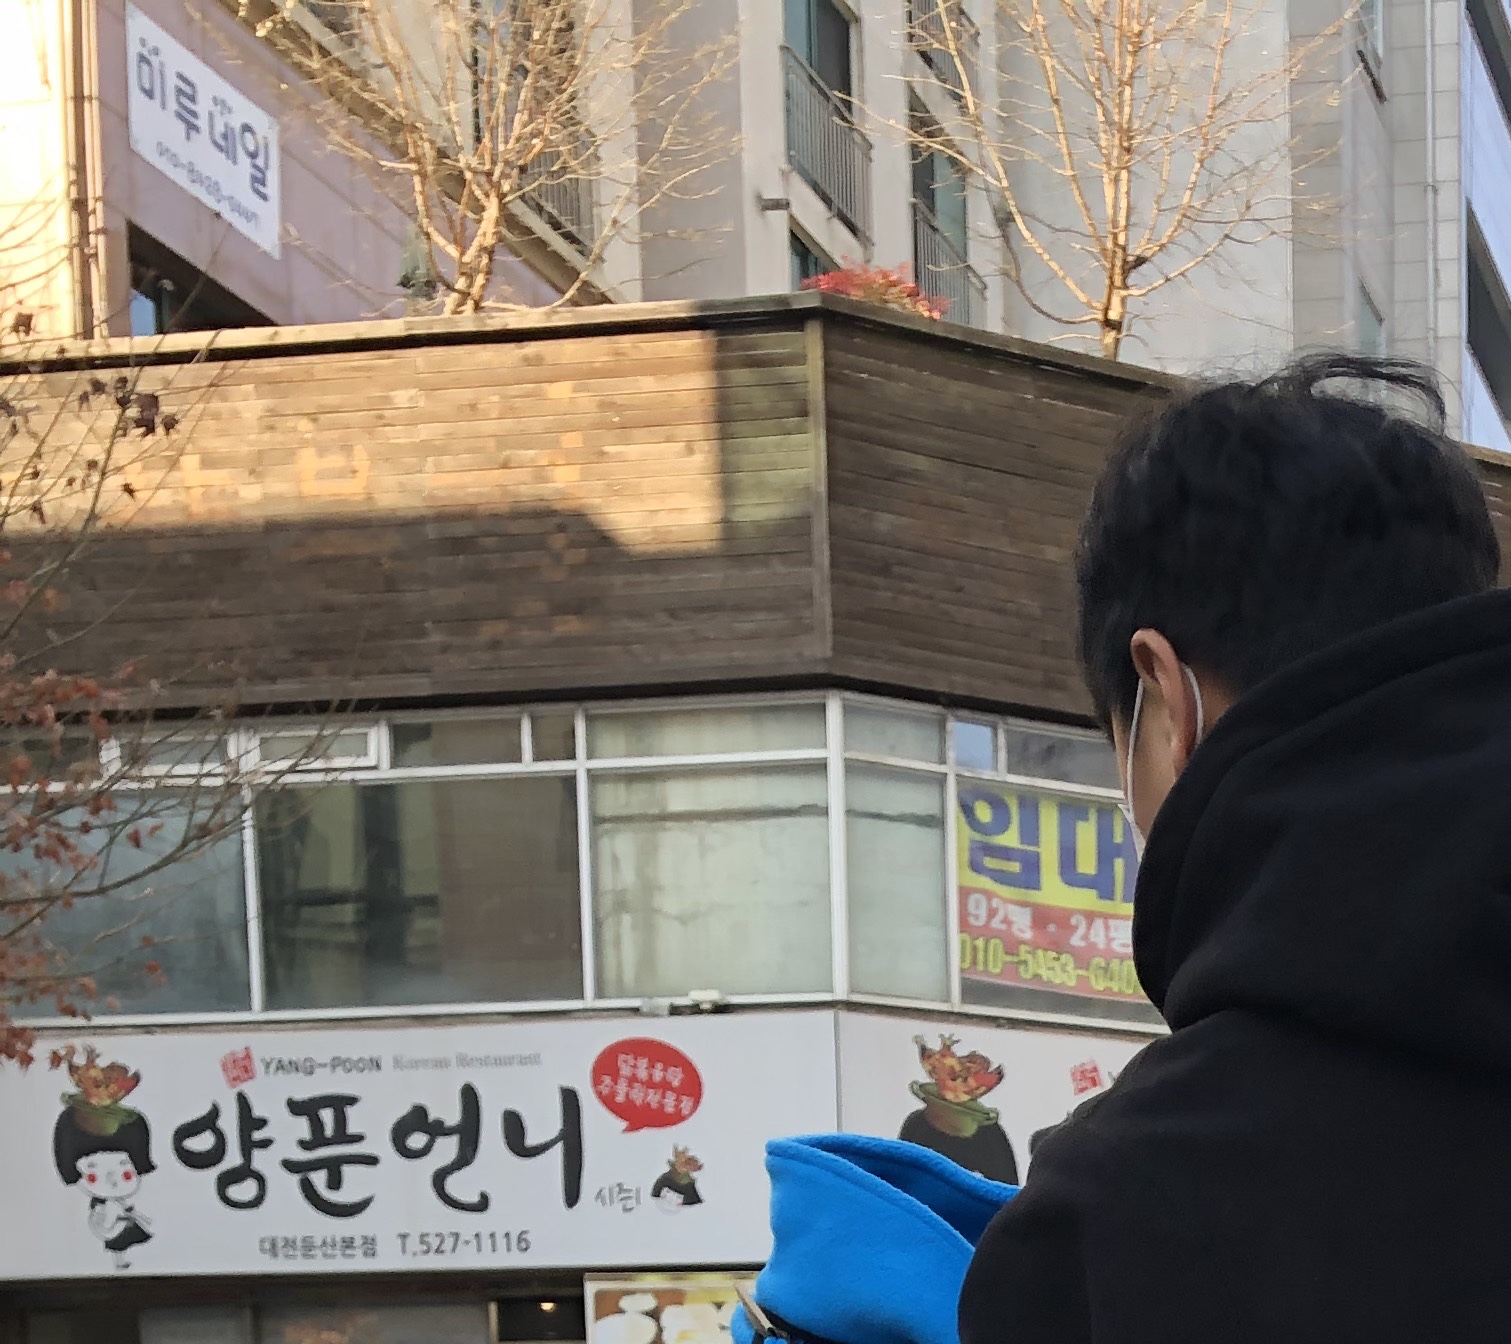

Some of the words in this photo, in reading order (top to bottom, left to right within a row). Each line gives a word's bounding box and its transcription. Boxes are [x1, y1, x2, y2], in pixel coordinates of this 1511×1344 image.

[136, 36, 269, 203] 미루네일
[959, 788, 1139, 904] 임대
[960, 933, 1145, 996] 010-5453-640
[260, 1055, 383, 1077] YANG-POON
[171, 1082, 583, 1218] 양푼언니
